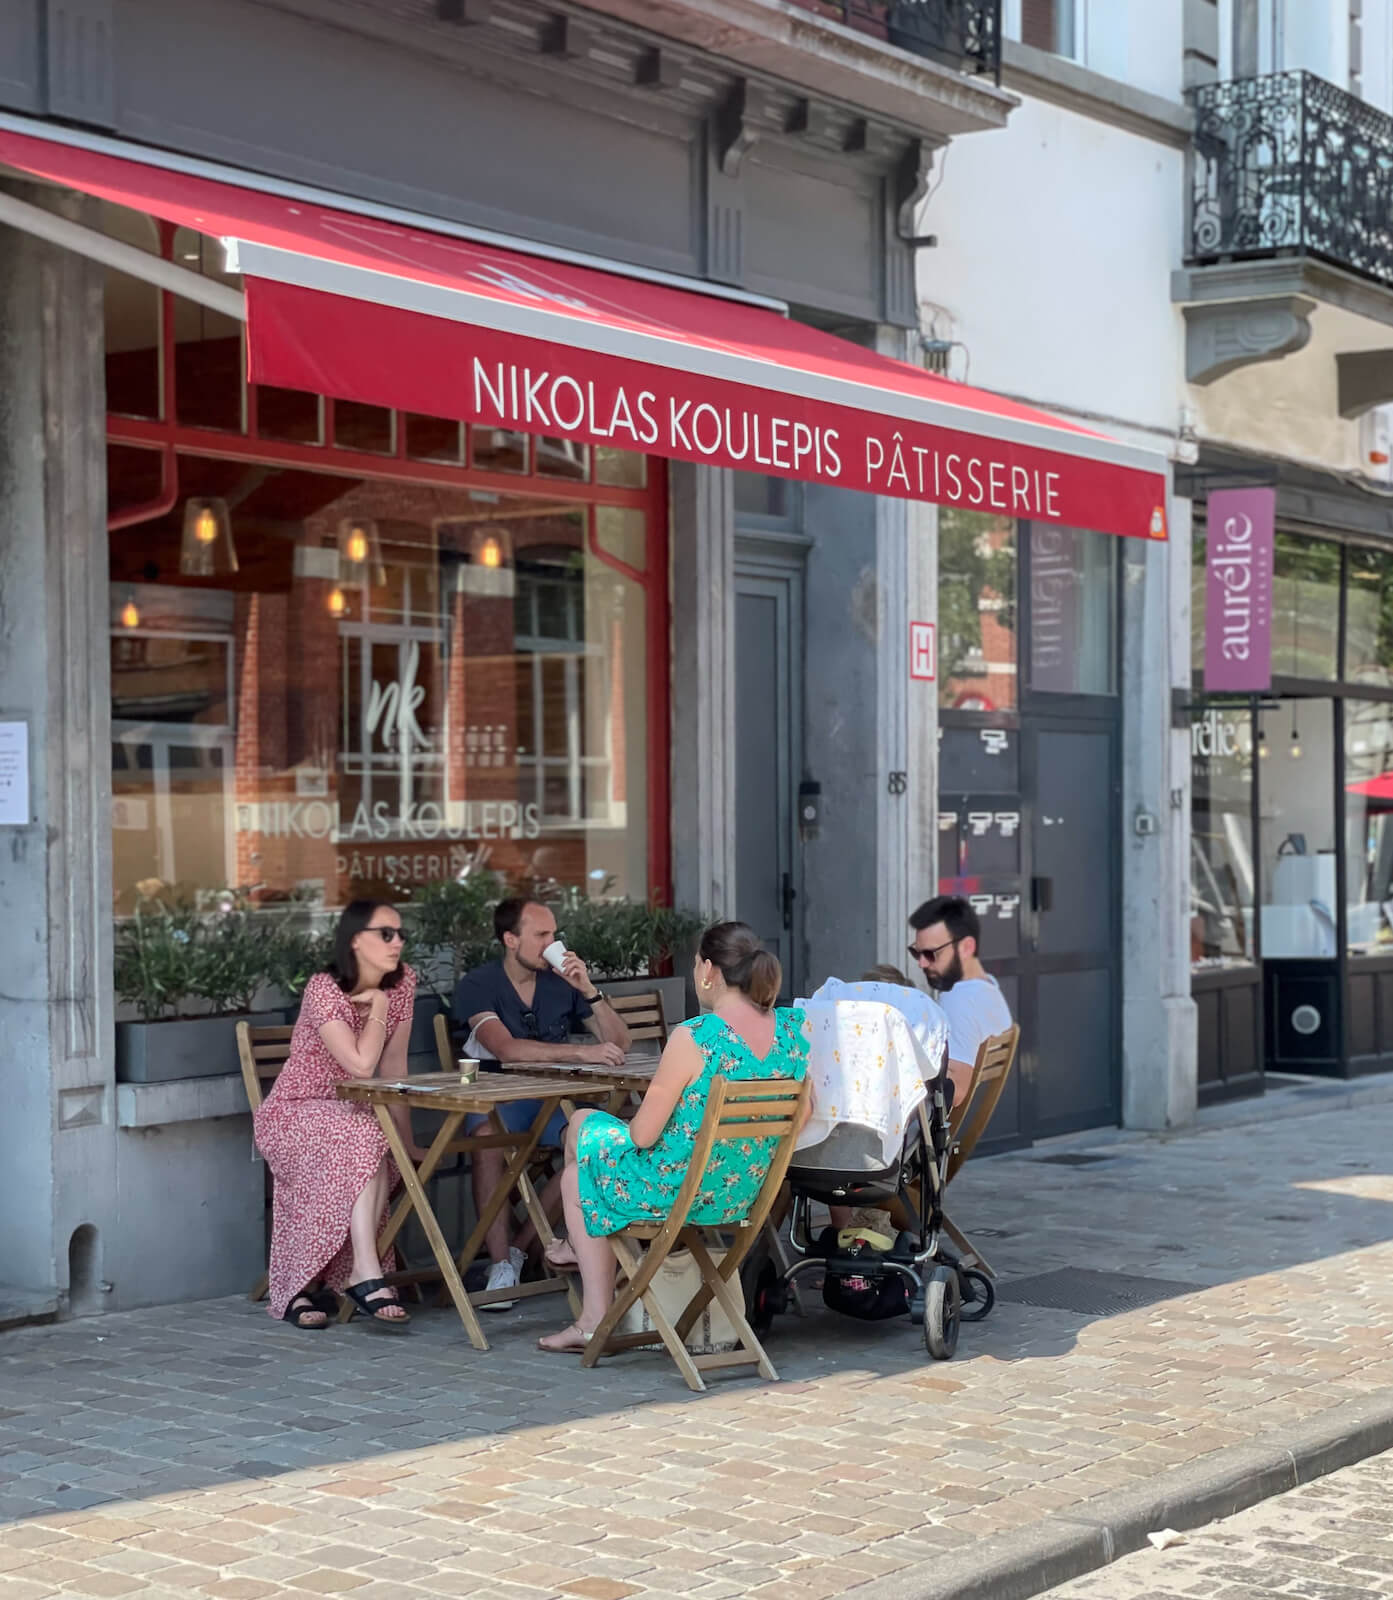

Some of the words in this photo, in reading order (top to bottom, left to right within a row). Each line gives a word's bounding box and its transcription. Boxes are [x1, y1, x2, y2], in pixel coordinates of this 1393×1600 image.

[473, 356, 659, 445] NIKOLAS
[669, 396, 842, 478] KOULEPIS
[865, 431, 1061, 517] PÂTISSERIE
[1211, 511, 1252, 661] aurélie
[366, 640, 433, 748] nk
[916, 632, 931, 670] H
